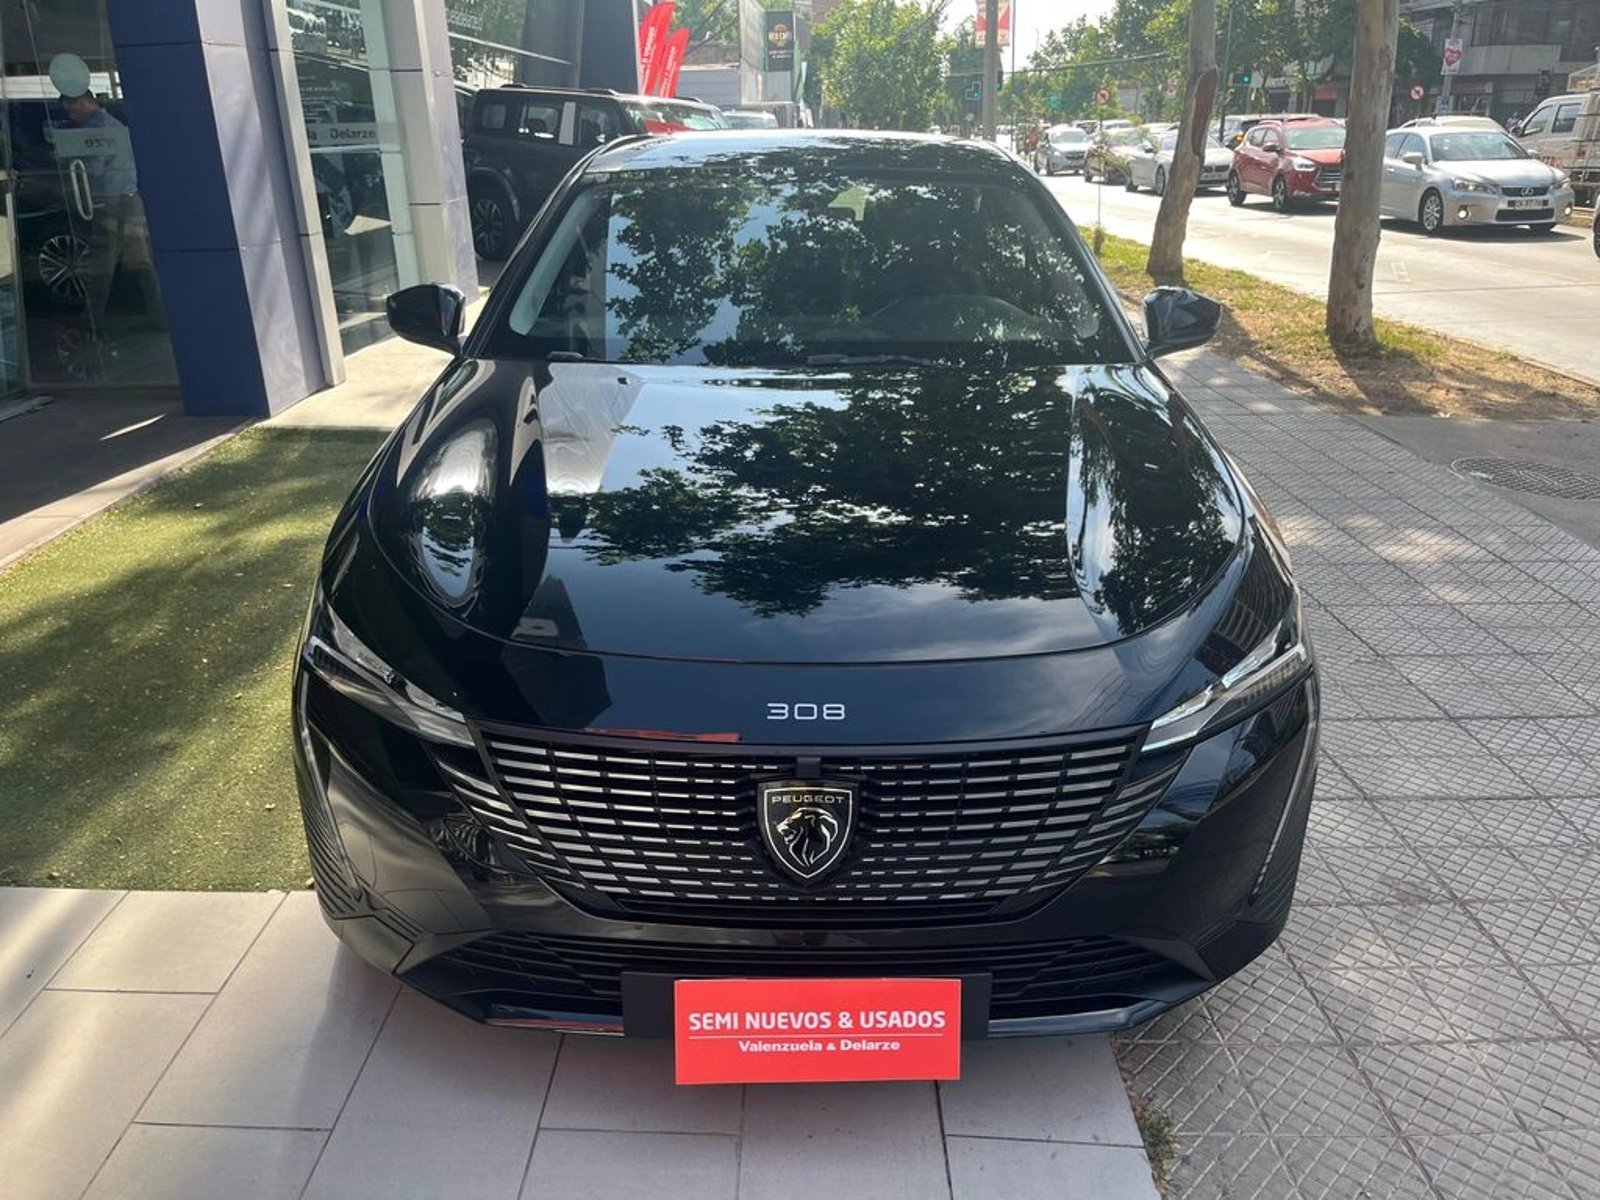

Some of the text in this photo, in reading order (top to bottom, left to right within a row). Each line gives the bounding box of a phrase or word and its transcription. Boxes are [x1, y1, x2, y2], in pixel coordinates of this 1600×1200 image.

[766, 702, 846, 720] 308
[771, 794, 845, 804] PEUGEOT
[688, 1010, 946, 1031] SEMI NUEVOS & USADOS
[738, 1039, 901, 1052] Valenzuela & Delarze
